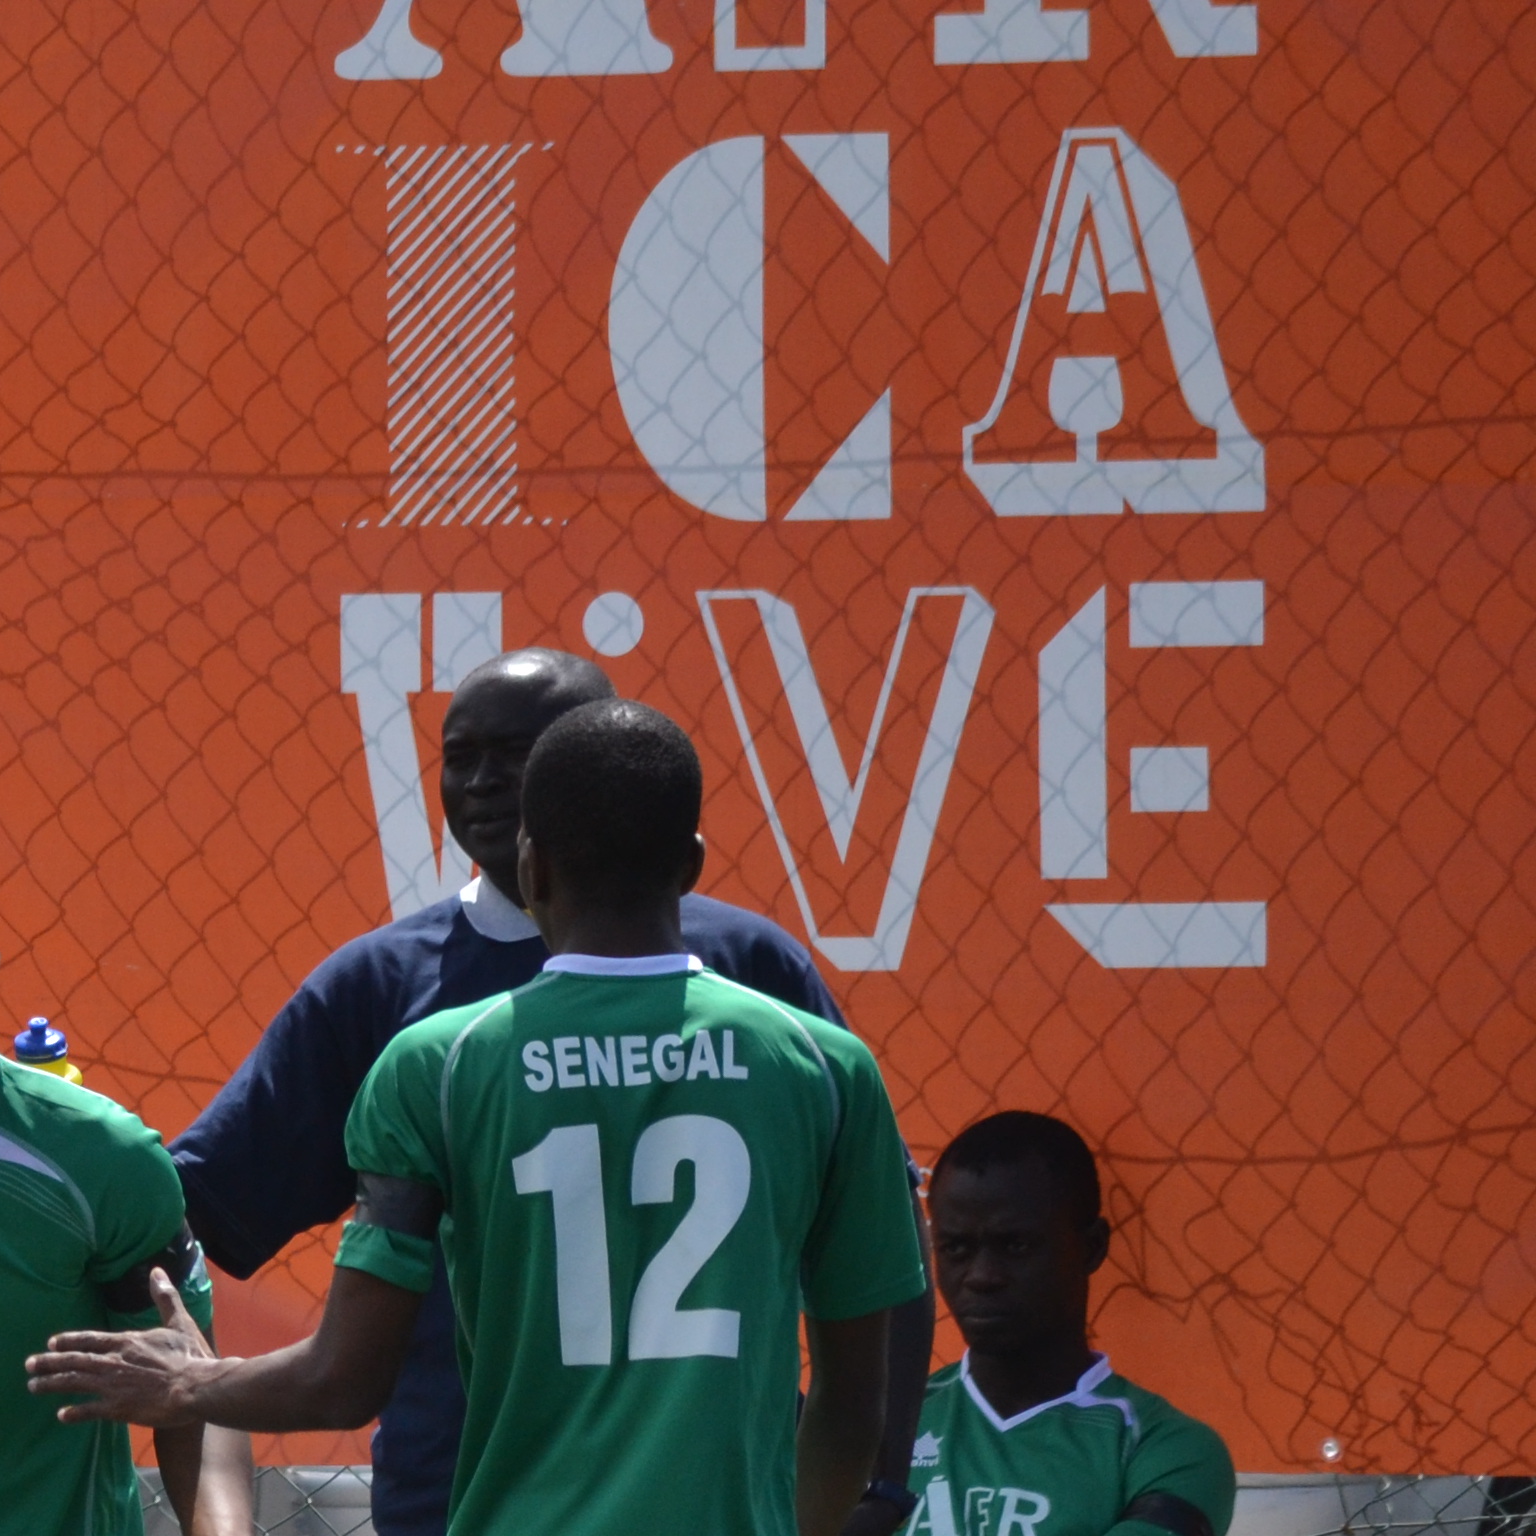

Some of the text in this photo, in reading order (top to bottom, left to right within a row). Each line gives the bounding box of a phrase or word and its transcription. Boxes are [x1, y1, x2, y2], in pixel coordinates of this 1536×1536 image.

[334, 126, 1266, 530] ICA
[340, 580, 1267, 972] VVE
[522, 1029, 749, 1092] SENEGAL
[511, 1114, 751, 1366] 12
